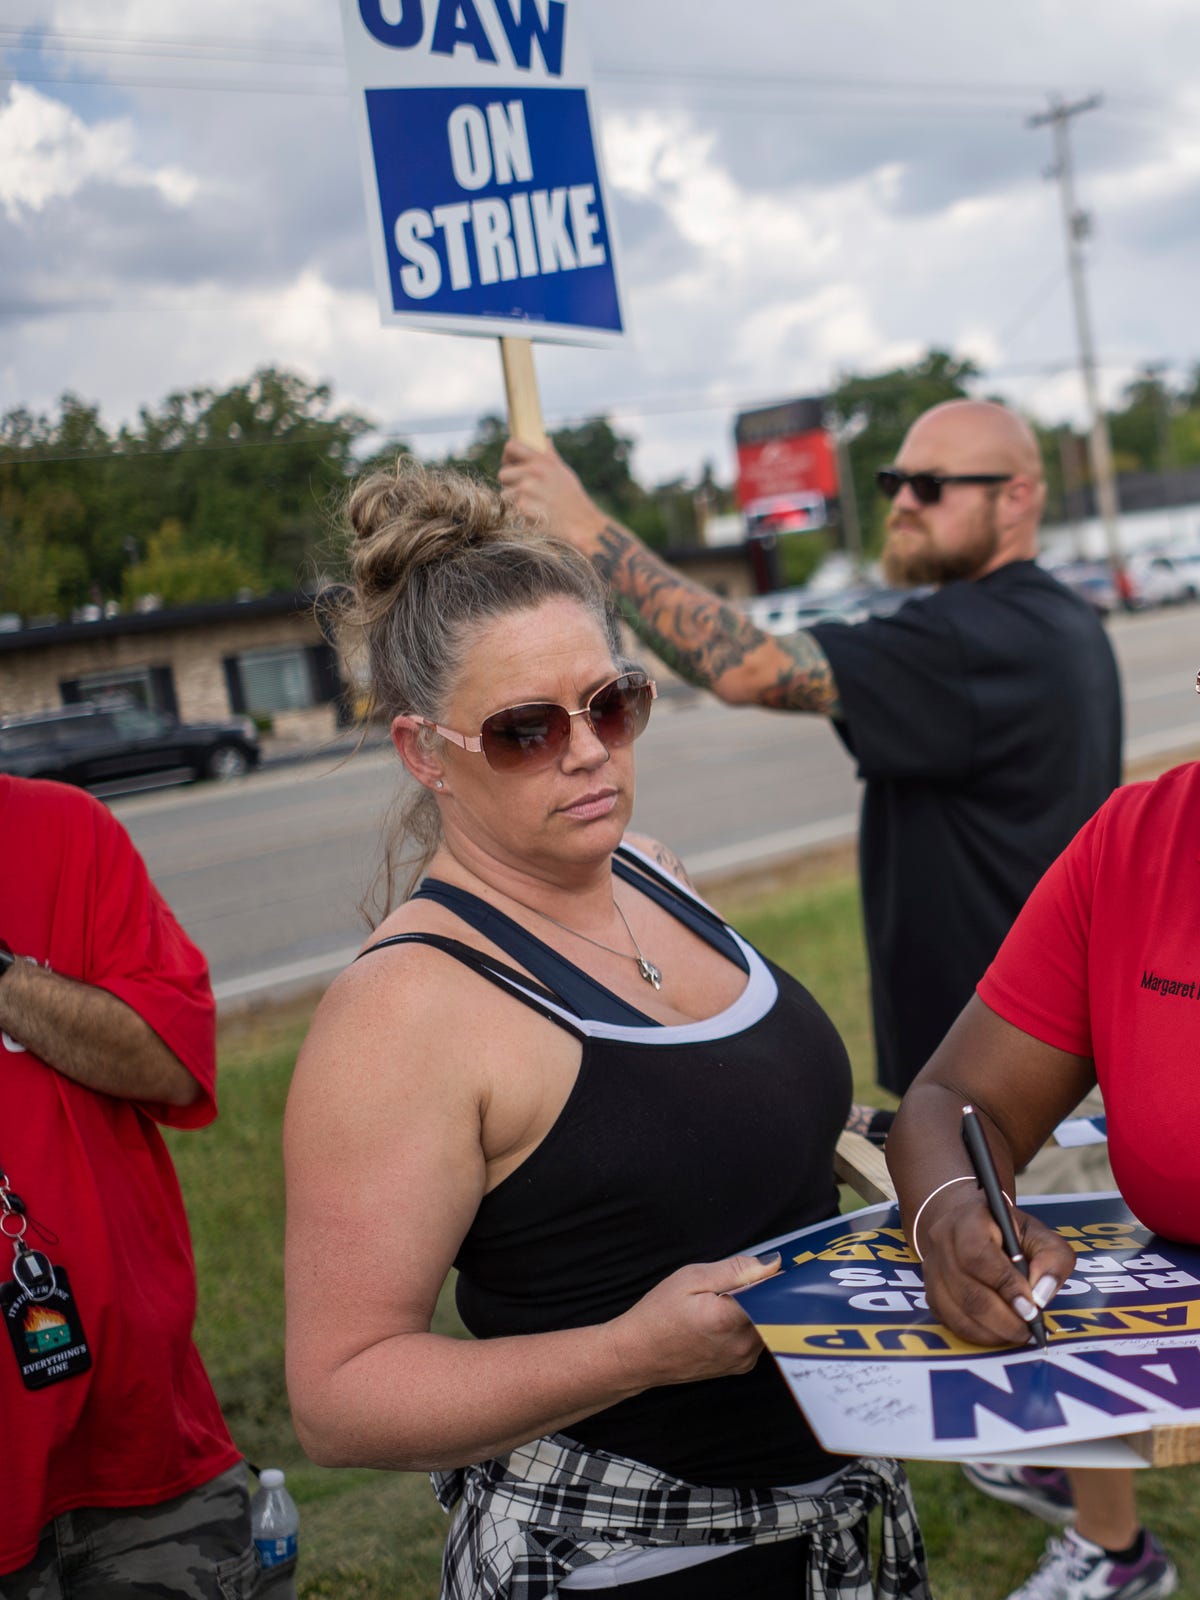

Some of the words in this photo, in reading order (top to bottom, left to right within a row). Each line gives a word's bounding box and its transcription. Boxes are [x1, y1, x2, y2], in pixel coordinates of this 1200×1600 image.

[358, 0, 568, 78] UAW
[447, 100, 534, 191] ON
[394, 184, 606, 300] STRIKE
[1140, 970, 1196, 999] Margaret
[803, 1328, 952, 1350] UP
[22, 1343, 88, 1375] EVERYTHING'S
[47, 1361, 70, 1377] FINE
